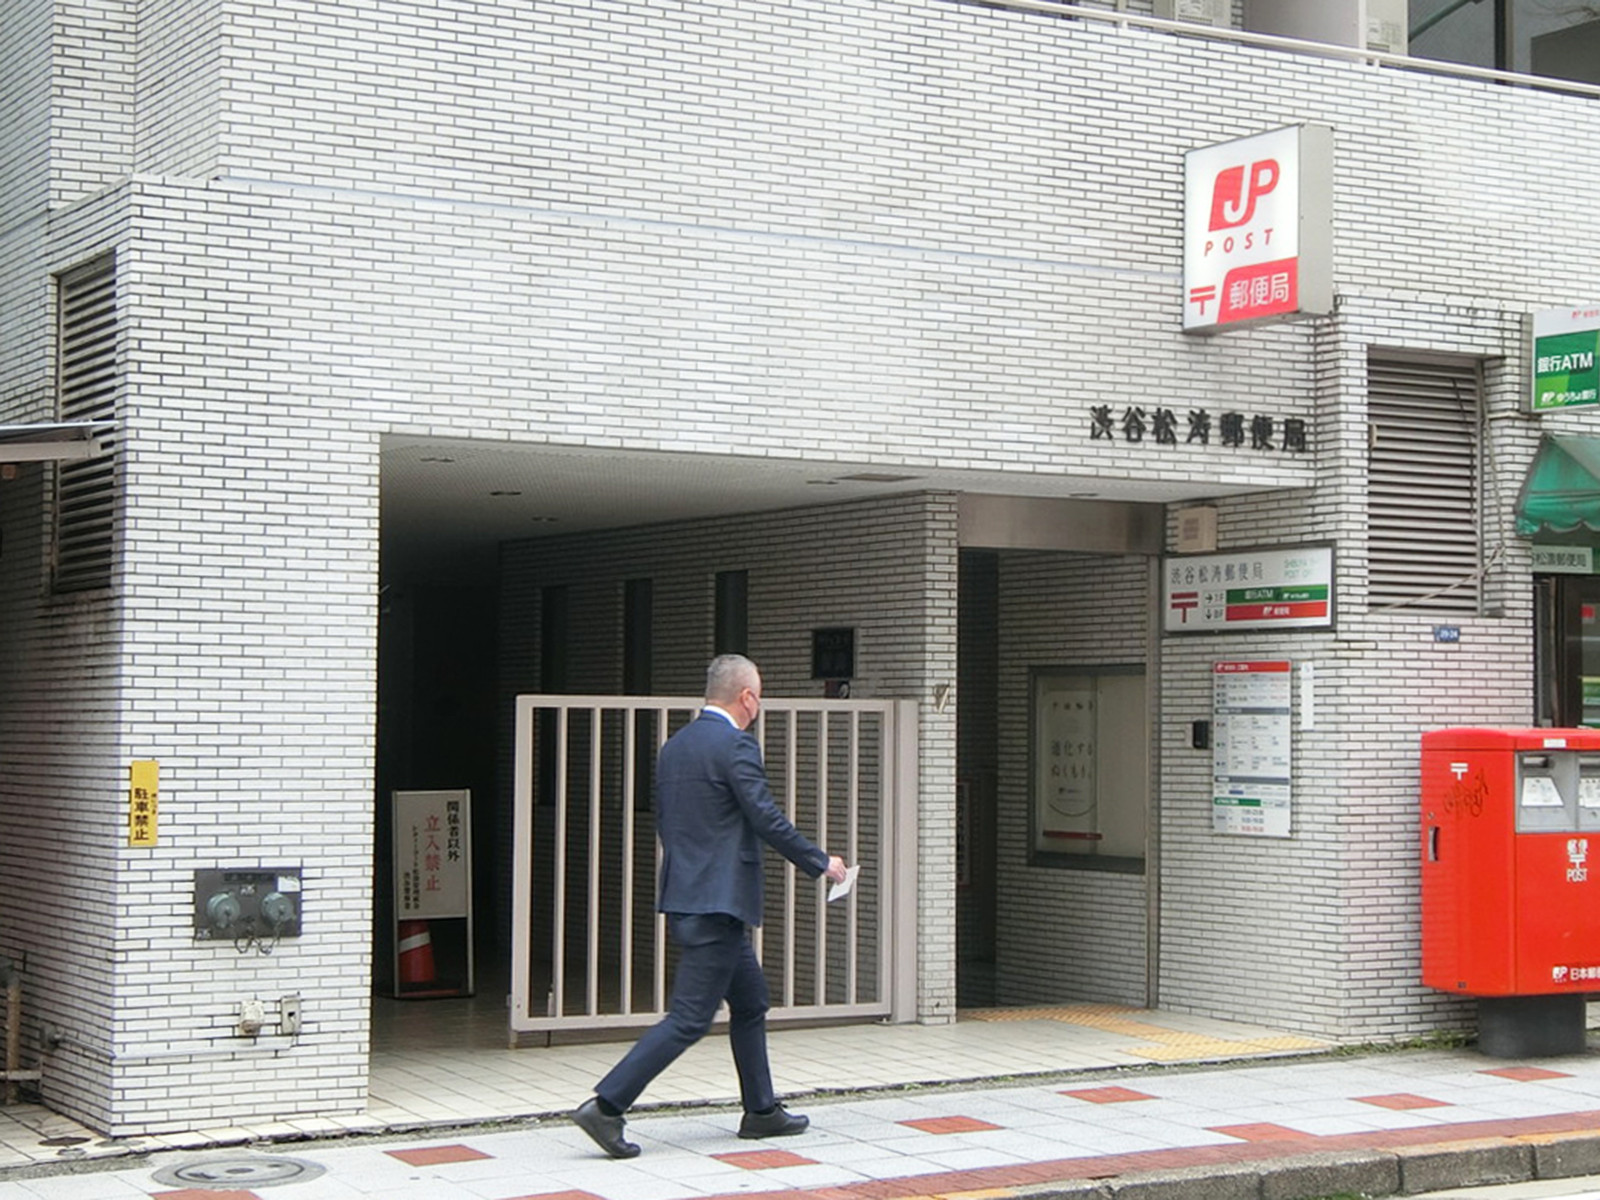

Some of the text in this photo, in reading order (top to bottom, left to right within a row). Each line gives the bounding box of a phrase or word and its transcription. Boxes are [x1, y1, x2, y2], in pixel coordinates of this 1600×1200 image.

[1209, 159, 1280, 232] JP
[1204, 228, 1274, 257] POST
[1229, 272, 1290, 309] 郵便局
[1537, 351, 1594, 374] 銀行ATM
[134, 788, 149, 841] 駐車禁止
[447, 801, 460, 863] 関係者以外
[424, 815, 441, 892] 立入禁止
[1567, 839, 1588, 855] 郵便
[1566, 868, 1588, 883] POST
